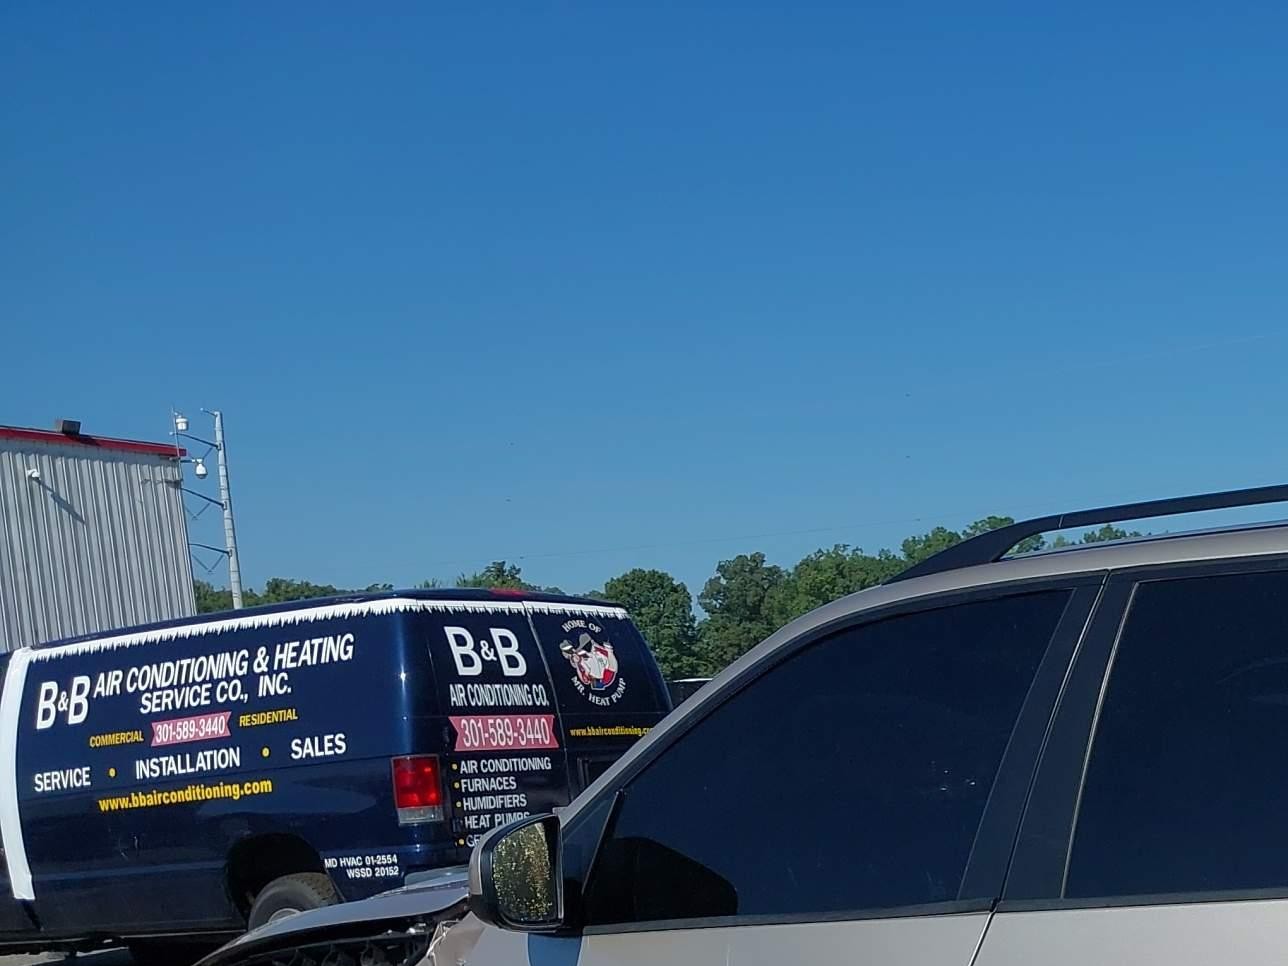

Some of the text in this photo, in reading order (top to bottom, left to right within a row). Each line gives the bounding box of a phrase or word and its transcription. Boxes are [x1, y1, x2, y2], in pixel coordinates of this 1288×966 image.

[561, 619, 602, 634] HOME OF
[443, 626, 527, 677] B&B
[36, 633, 355, 730] B&B AIR CONDITIONING & HEATING
[139, 672, 293, 715] SERVICE CO., INC.
[570, 676, 627, 706] MR. HEAT PUMP
[450, 683, 550, 708] AIR CONDITIONING CO.
[89, 708, 299, 748] COMMERCIAL 301-589-3440 RESIDENTIAL
[460, 717, 550, 748] 301-589-3440
[34, 733, 347, 793] SERVICE INSTALLATION SALES
[459, 757, 552, 774] AIR CONDITIONING
[98, 777, 273, 812] www.bbairconditioning.com
[461, 776, 517, 793] FURNACES
[463, 794, 527, 811] HUMIDIFIERS
[464, 814, 491, 829] HEAT
[324, 854, 398, 869] MD HVAC 01-2554
[346, 866, 399, 879] WSSD 20152
